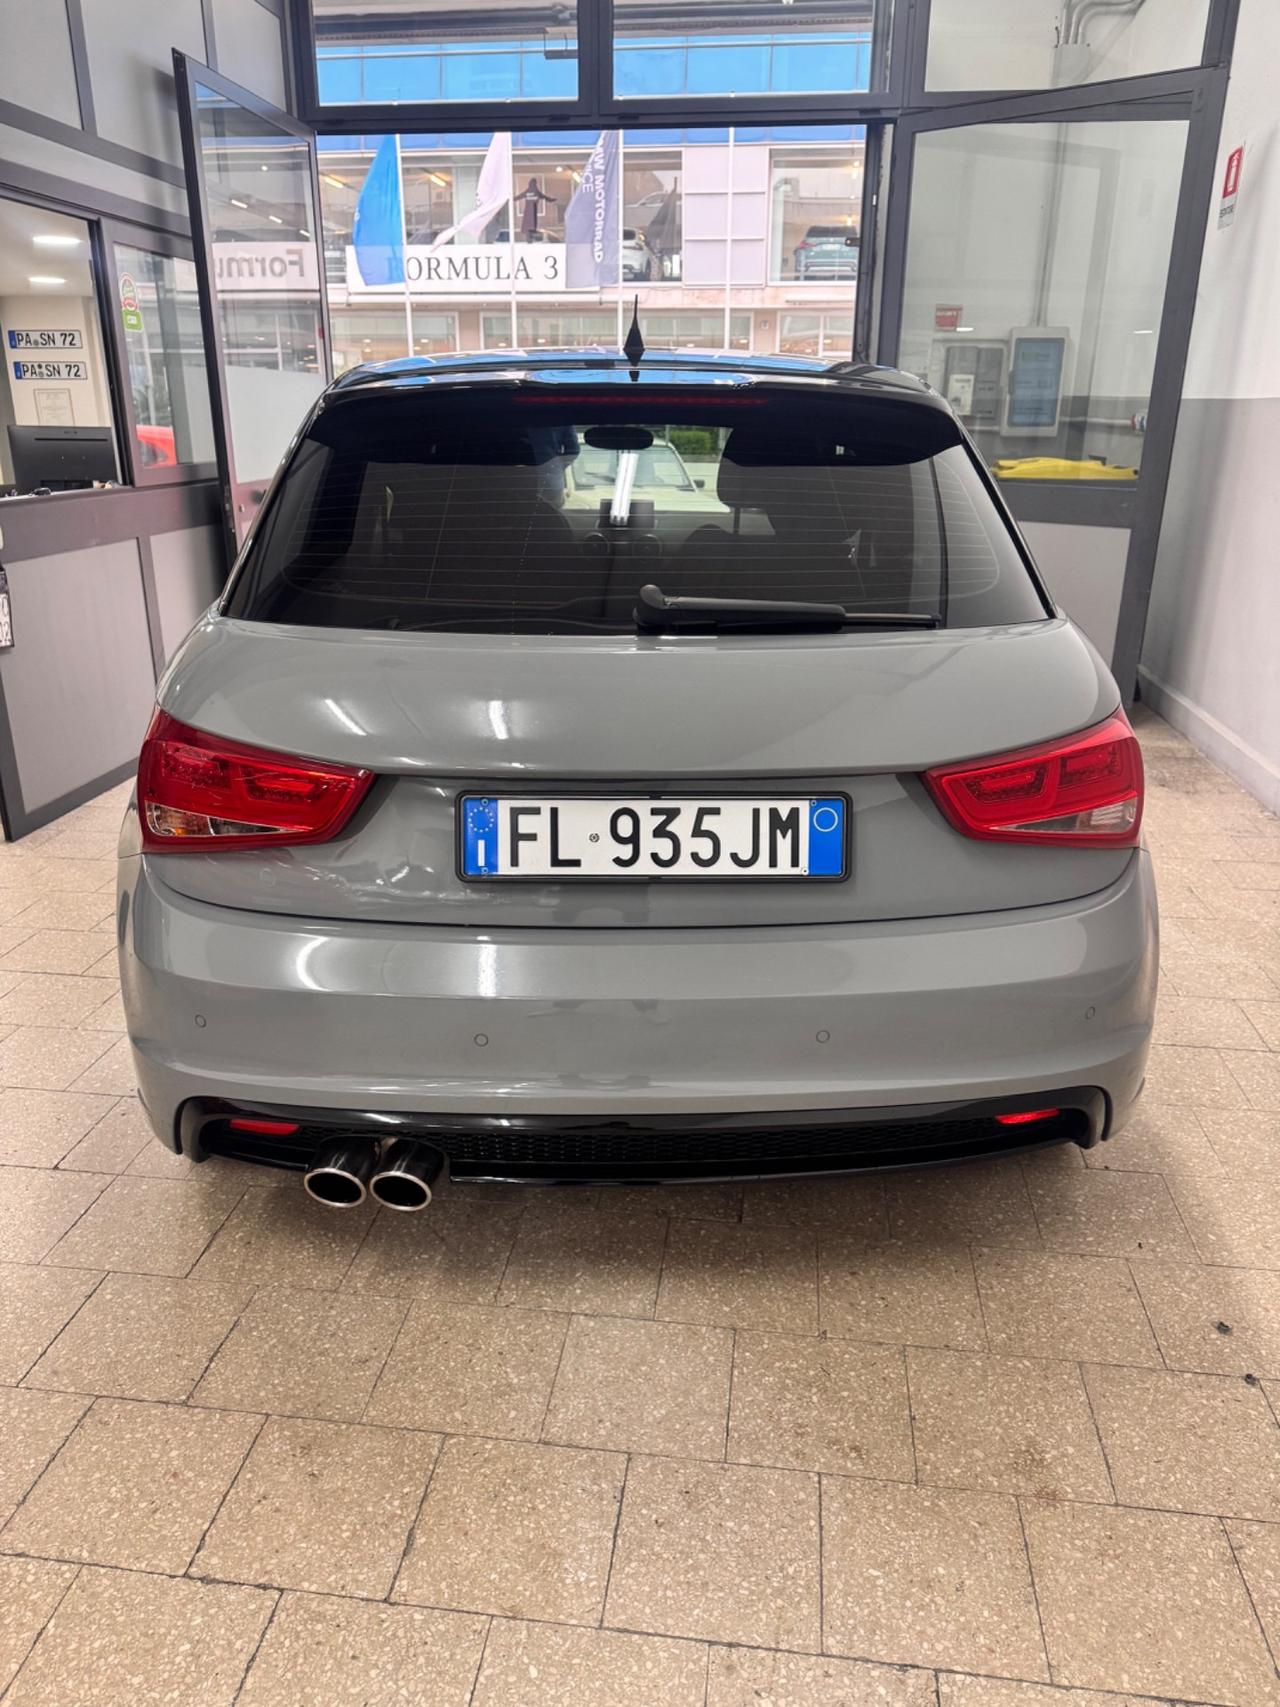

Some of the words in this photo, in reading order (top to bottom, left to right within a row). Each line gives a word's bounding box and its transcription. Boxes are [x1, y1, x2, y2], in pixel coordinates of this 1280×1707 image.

[593, 174, 606, 263] MOTORRAD
[544, 255, 559, 280] 3
[16, 333, 32, 346] PA
[40, 333, 56, 346] SN
[60, 333, 76, 346] 72
[22, 364, 37, 377] PA
[45, 364, 61, 377] SN
[65, 364, 81, 377] 72
[509, 806, 582, 868] FL
[609, 806, 800, 868] 935JM
